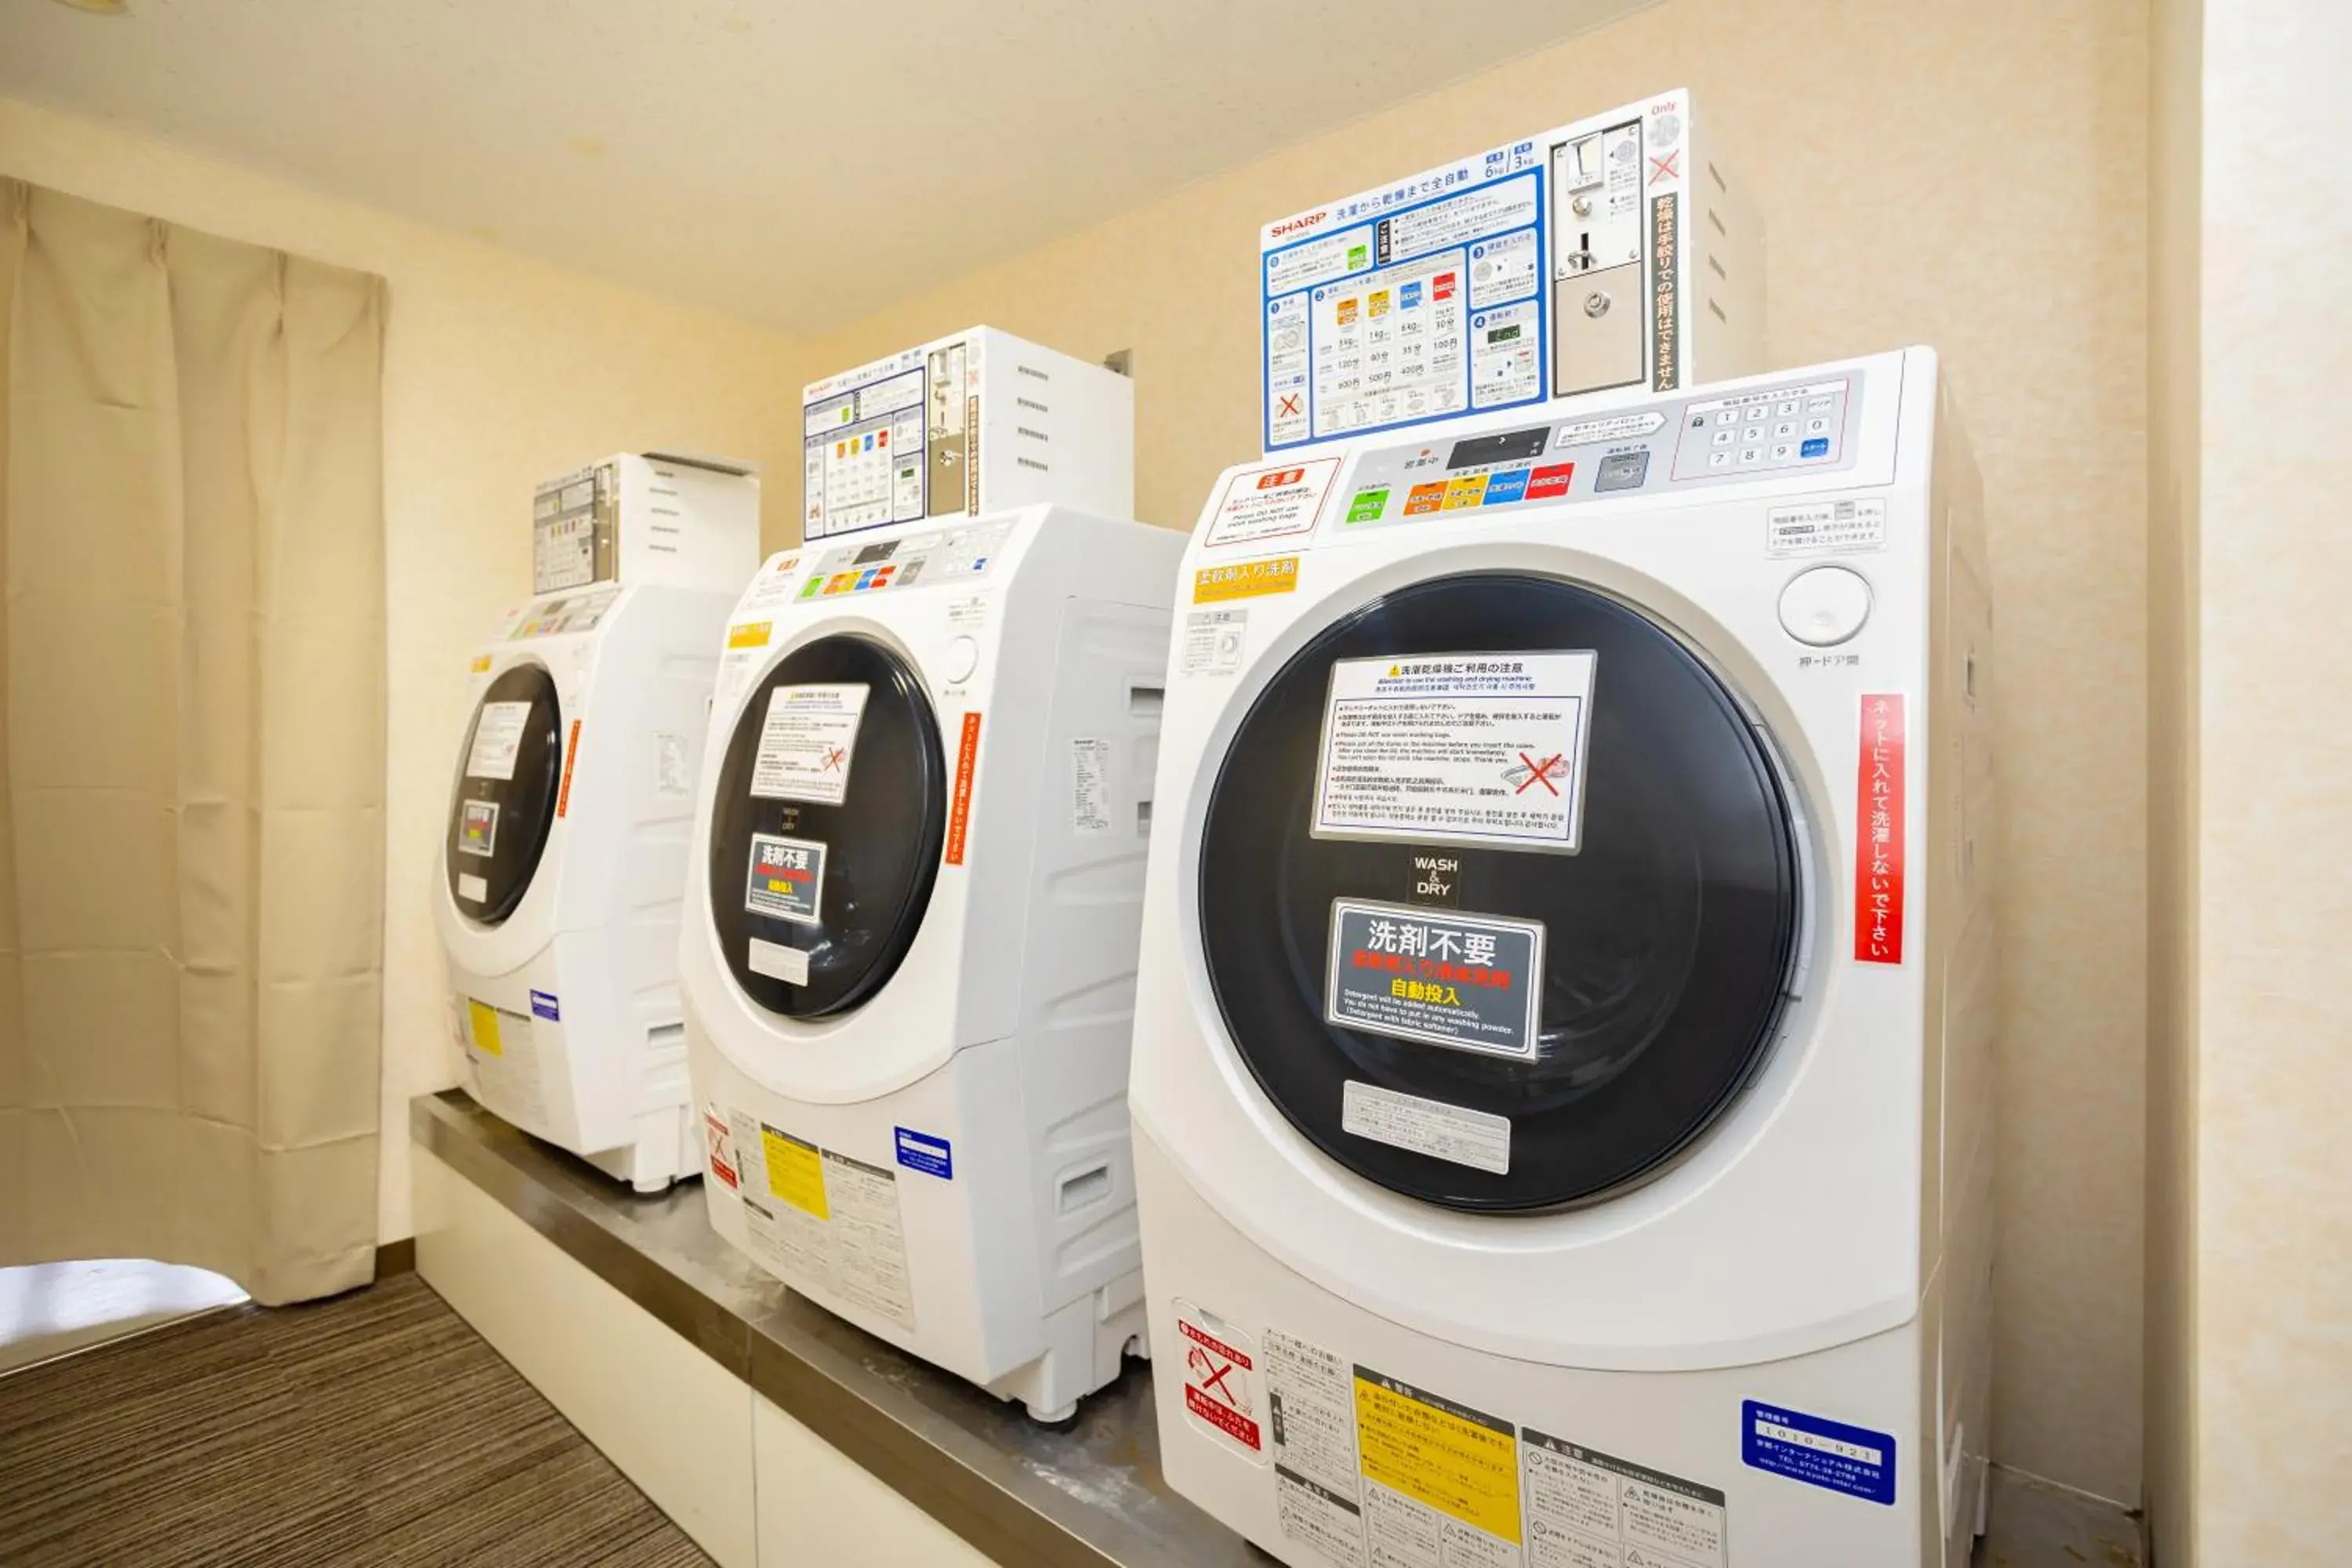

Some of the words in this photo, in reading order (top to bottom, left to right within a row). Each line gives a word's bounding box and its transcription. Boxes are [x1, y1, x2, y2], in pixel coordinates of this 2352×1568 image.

[1652, 101, 1676, 115] Only
[1336, 169, 1469, 221] 洗濯から乾燥まで全自動
[1271, 212, 1327, 238] SHARP
[1656, 196, 1675, 390] 乾燥は手絞りでの使用はできません
[1753, 408, 1762, 417] 2
[1784, 404, 1792, 413] 3
[1719, 433, 1727, 441] 4
[1749, 429, 1757, 438] 5
[1780, 425, 1789, 434] 6
[1716, 454, 1724, 464] 7
[1745, 450, 1755, 460] 8
[1777, 446, 1786, 456] 9
[1401, 662, 1524, 675] 洗濯乾燥機ご利用の注意
[1869, 699, 1891, 956] ネットに入れて洗濯しないで下さい
[1415, 857, 1458, 873] WASH
[1429, 871, 1439, 883] &
[1417, 882, 1451, 896] DRY
[1368, 920, 1497, 967] 洗剤不要
[1345, 989, 1377, 1001] Detergent
[1403, 1000, 1425, 1009] added
[1427, 1004, 1480, 1019] automatically.
[1392, 978, 1461, 1007] 自動投入
[1345, 1006, 1382, 1020] (Detergent
[1385, 1014, 1399, 1022] with
[1401, 1016, 1421, 1028] fabric
[1423, 1022, 1459, 1035] softener)
[1381, 1004, 1397, 1013] have
[1409, 1010, 1421, 1019] put
[1432, 1014, 1445, 1022] any
[1446, 1017, 1479, 1030] washing
